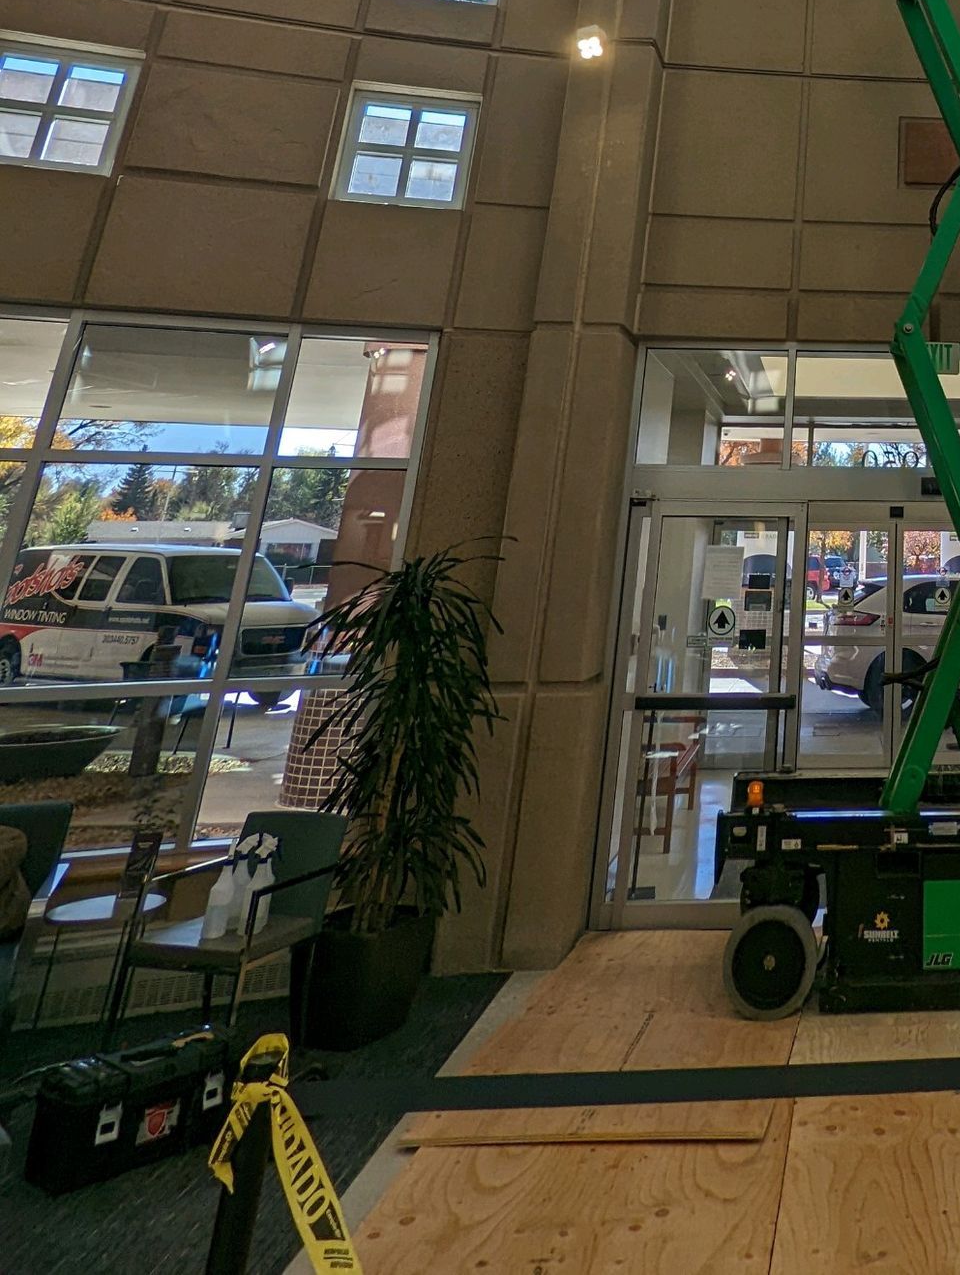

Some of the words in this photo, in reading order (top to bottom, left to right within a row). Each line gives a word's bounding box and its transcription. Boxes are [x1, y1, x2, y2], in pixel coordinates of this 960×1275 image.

[926, 343, 953, 372] XIT
[4, 609, 37, 622] WINDOW
[37, 610, 67, 624] TINTING
[863, 930, 899, 939] SUNBELT
[925, 952, 954, 966] JLG
